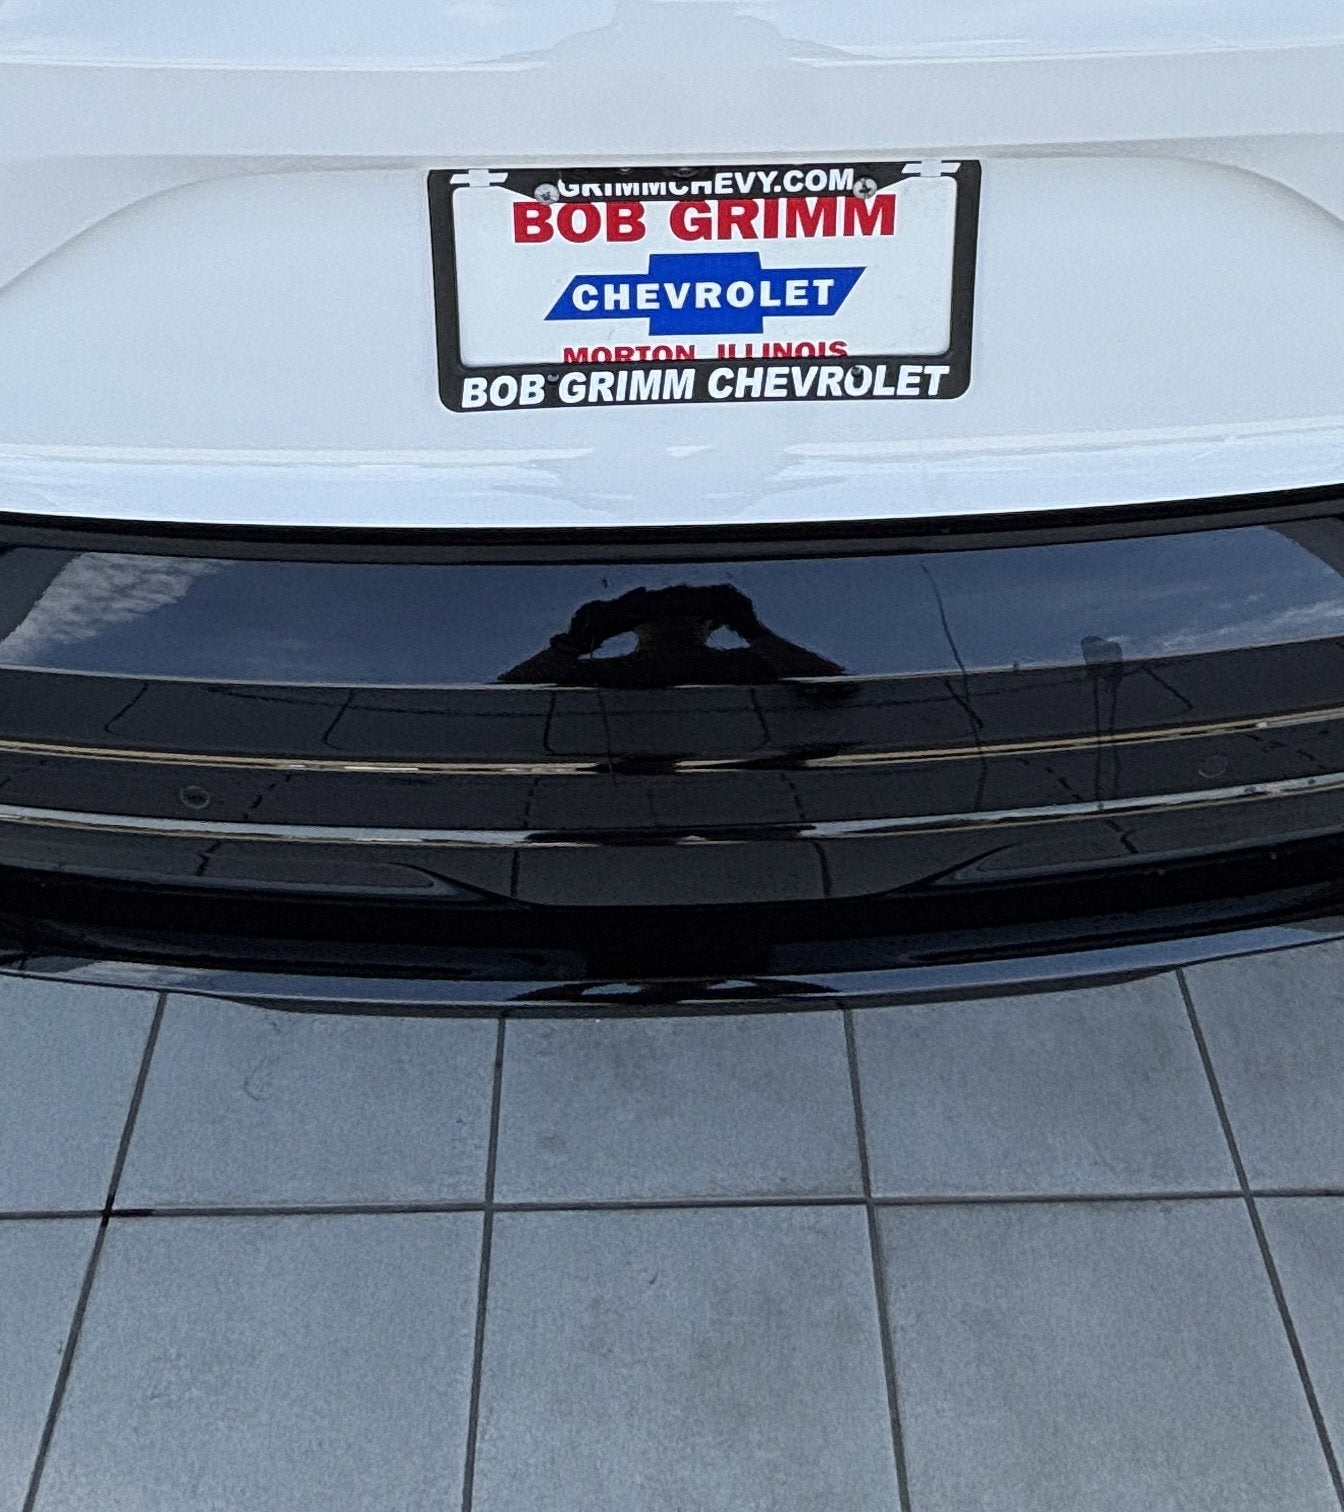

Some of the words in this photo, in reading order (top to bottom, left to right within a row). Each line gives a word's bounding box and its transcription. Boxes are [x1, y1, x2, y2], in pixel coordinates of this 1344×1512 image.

[513, 201, 647, 244] BOB
[669, 194, 897, 241] GRIMM
[572, 279, 835, 312] CHEVROLET
[461, 374, 546, 409] BOB
[558, 368, 697, 404] GRIMM
[708, 364, 951, 400] CHEVROLET
